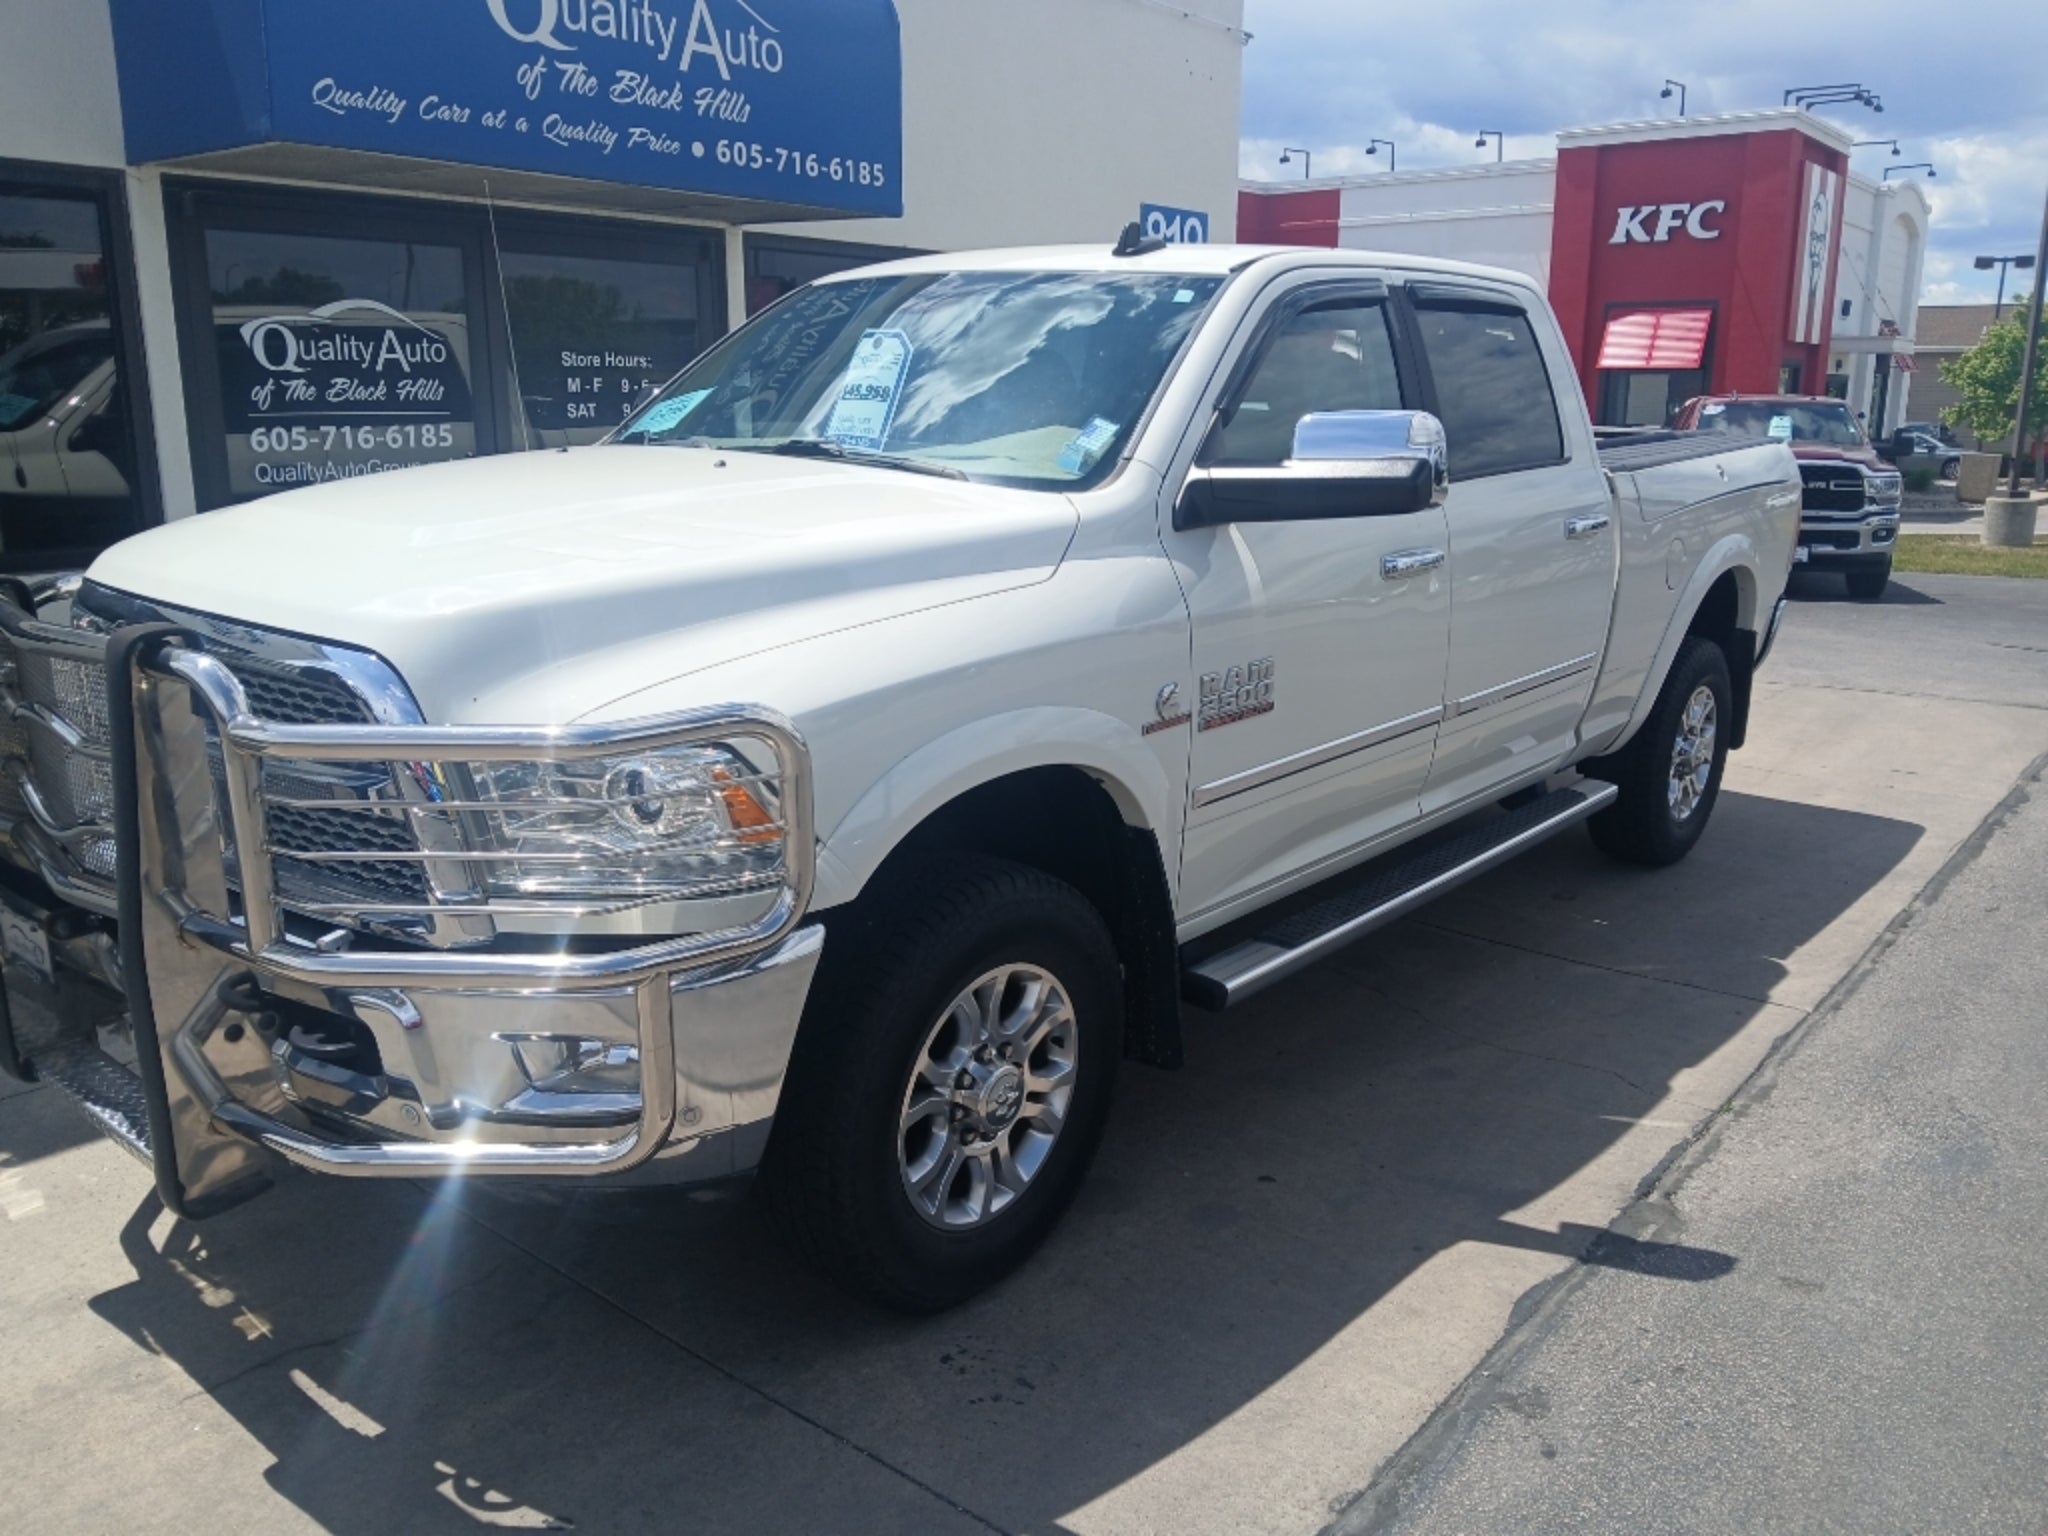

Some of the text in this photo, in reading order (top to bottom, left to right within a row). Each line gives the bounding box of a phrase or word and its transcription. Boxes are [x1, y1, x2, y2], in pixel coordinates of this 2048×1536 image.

[679, 0, 784, 80] Auto
[516, 55, 751, 123] of The Black Hills
[312, 77, 885, 187] Quality Cars at a Quality Price 605-716-6185
[1608, 199, 1725, 244] KFC
[252, 323, 447, 372] Quality Auto
[561, 351, 653, 369] Store Hours:
[251, 376, 445, 411] of The Black Hills
[567, 403, 597, 418] SAT
[250, 423, 453, 452] 605-716-6185
[1200, 656, 1274, 697] RAM
